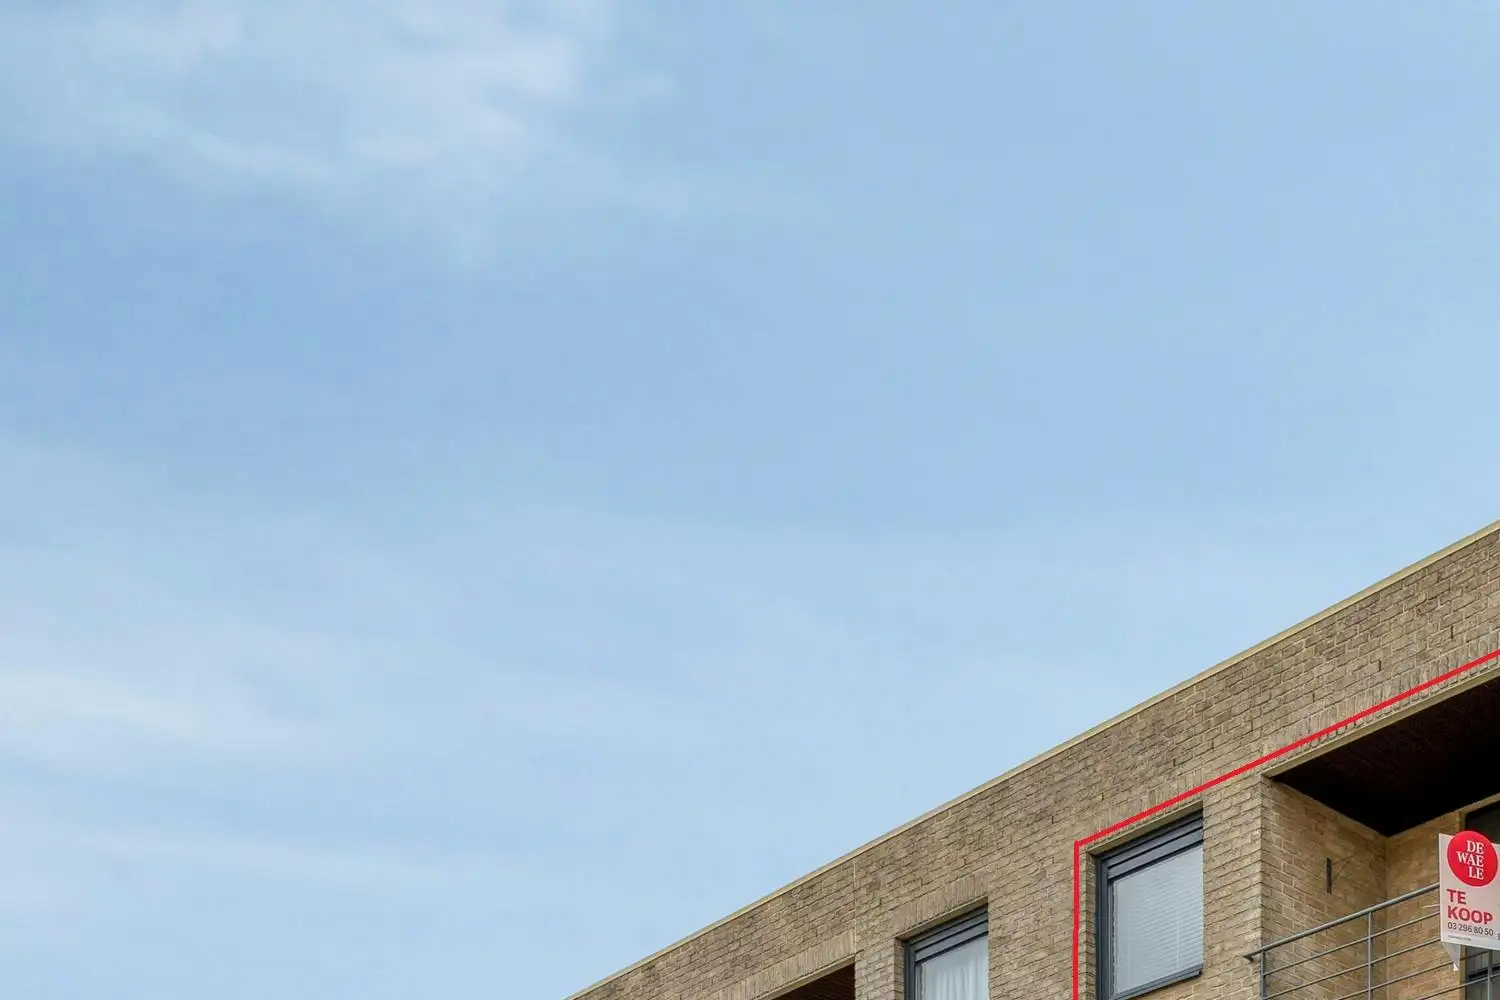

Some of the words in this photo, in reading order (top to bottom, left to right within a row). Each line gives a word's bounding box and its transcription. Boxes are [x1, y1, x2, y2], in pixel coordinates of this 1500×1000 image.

[1467, 840, 1484, 854] DE
[1456, 851, 1484, 868] WAE
[1468, 866, 1484, 880] LE
[1446, 888, 1467, 905] TE
[1447, 905, 1494, 925] KOOP
[1447, 921, 1457, 930] 03
[1484, 928, 1494, 937] 50
